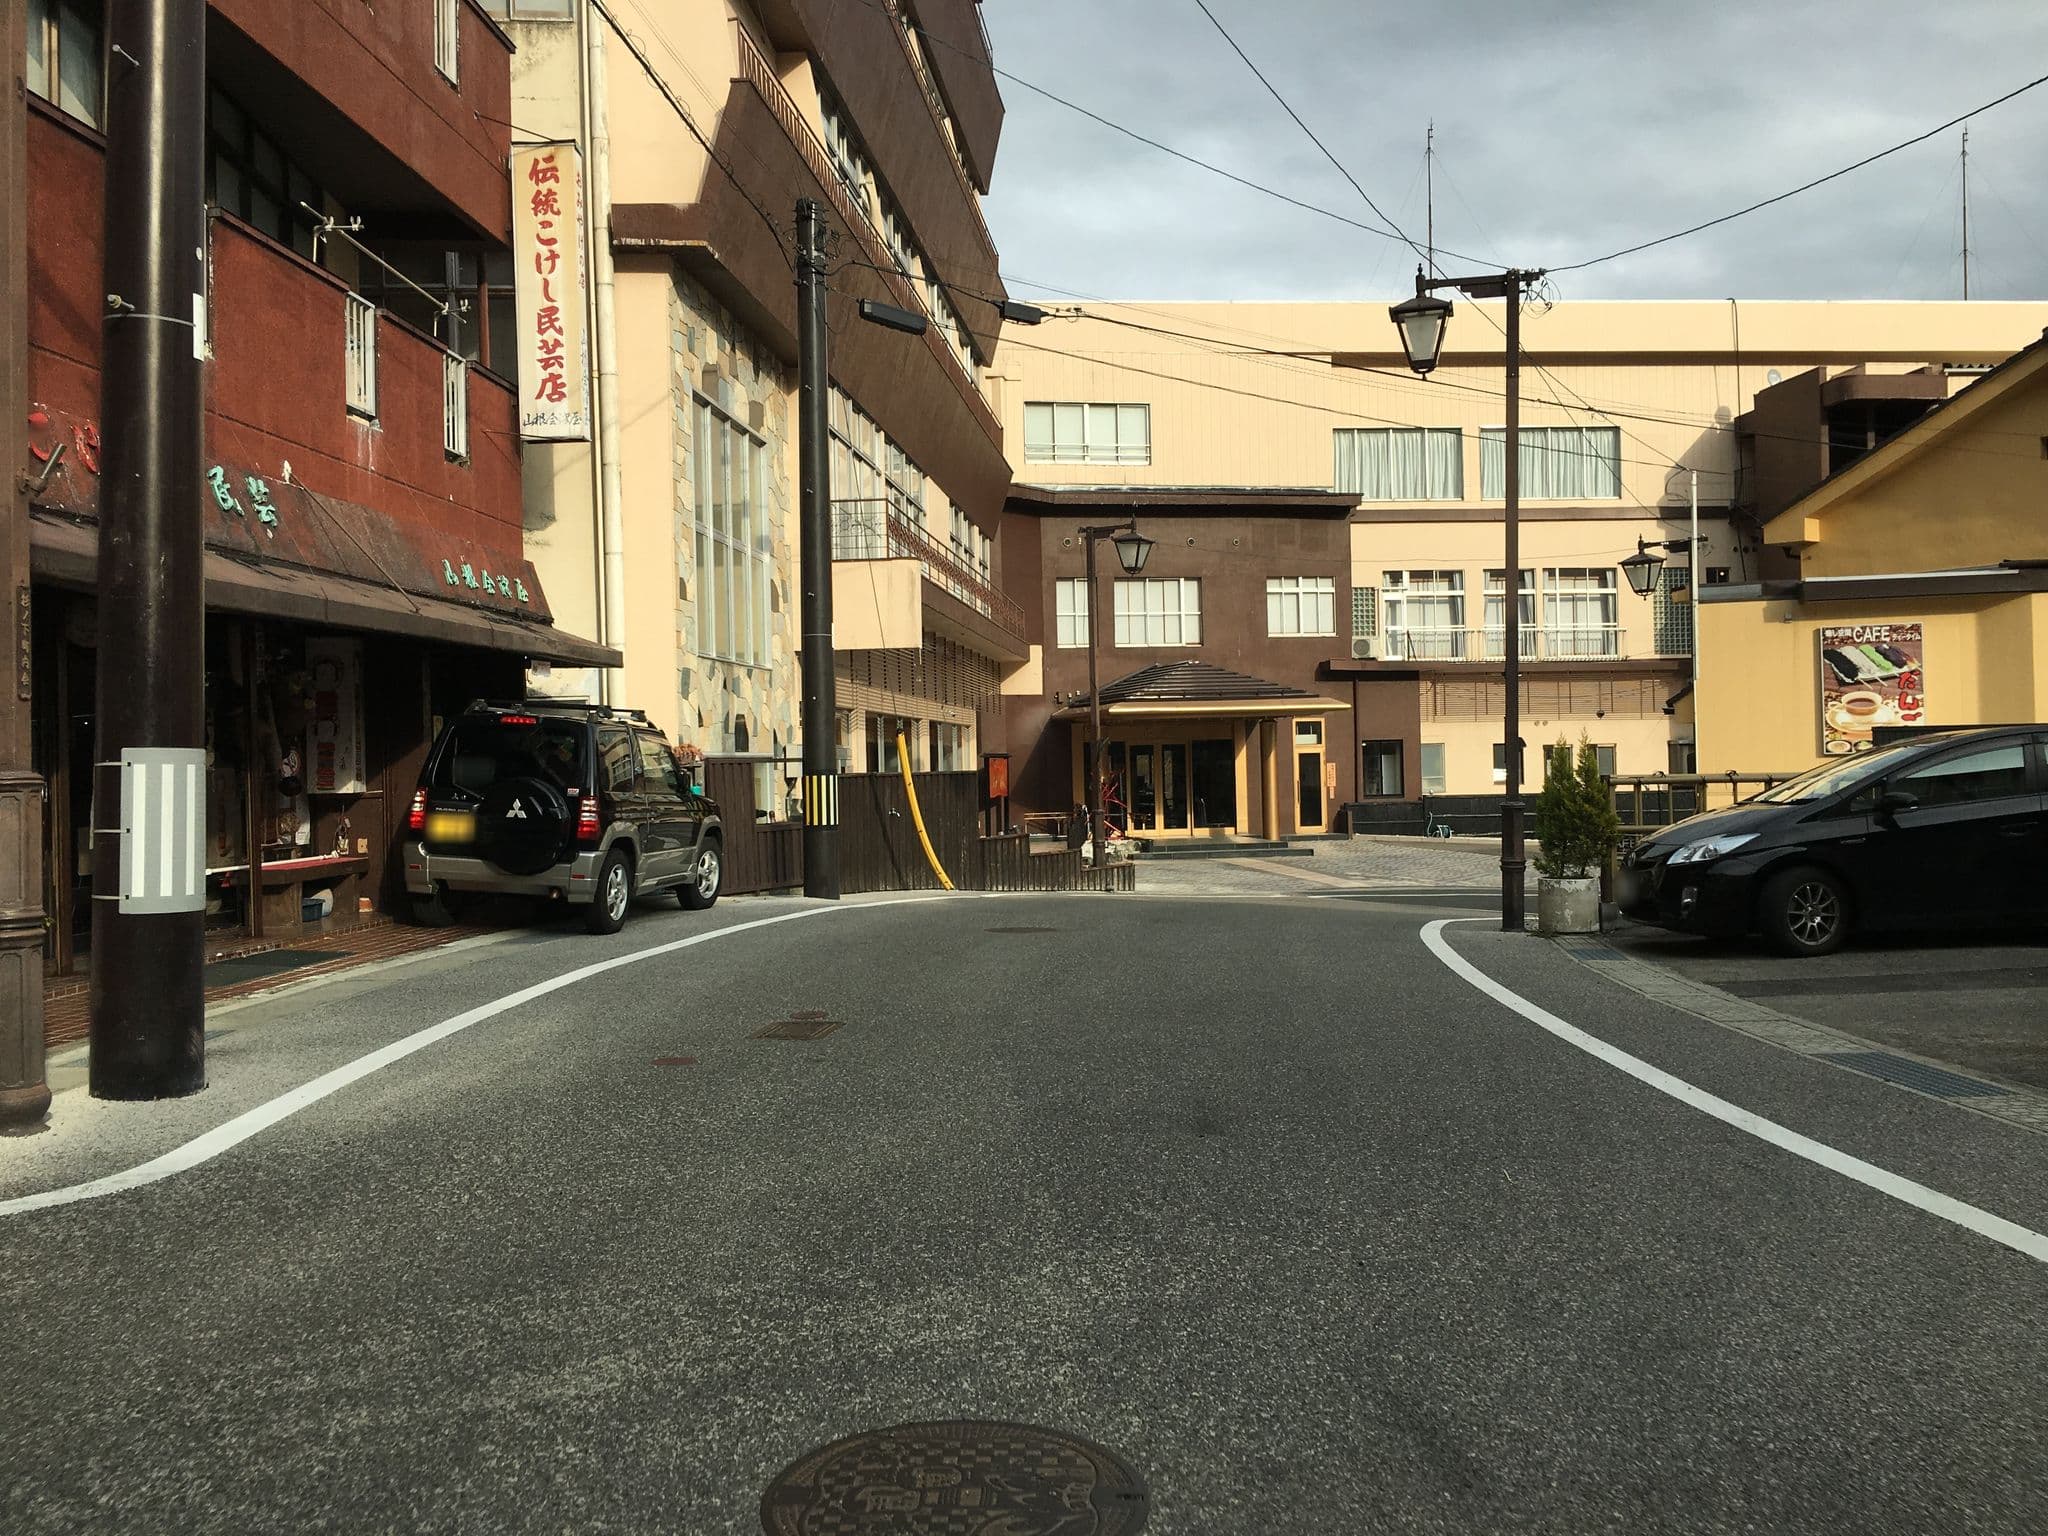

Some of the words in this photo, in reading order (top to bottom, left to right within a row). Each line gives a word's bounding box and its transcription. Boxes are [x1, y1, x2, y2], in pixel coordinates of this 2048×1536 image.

[528, 154, 568, 404] 伝統こけし民芸店
[1853, 626, 1890, 643] CAFE
